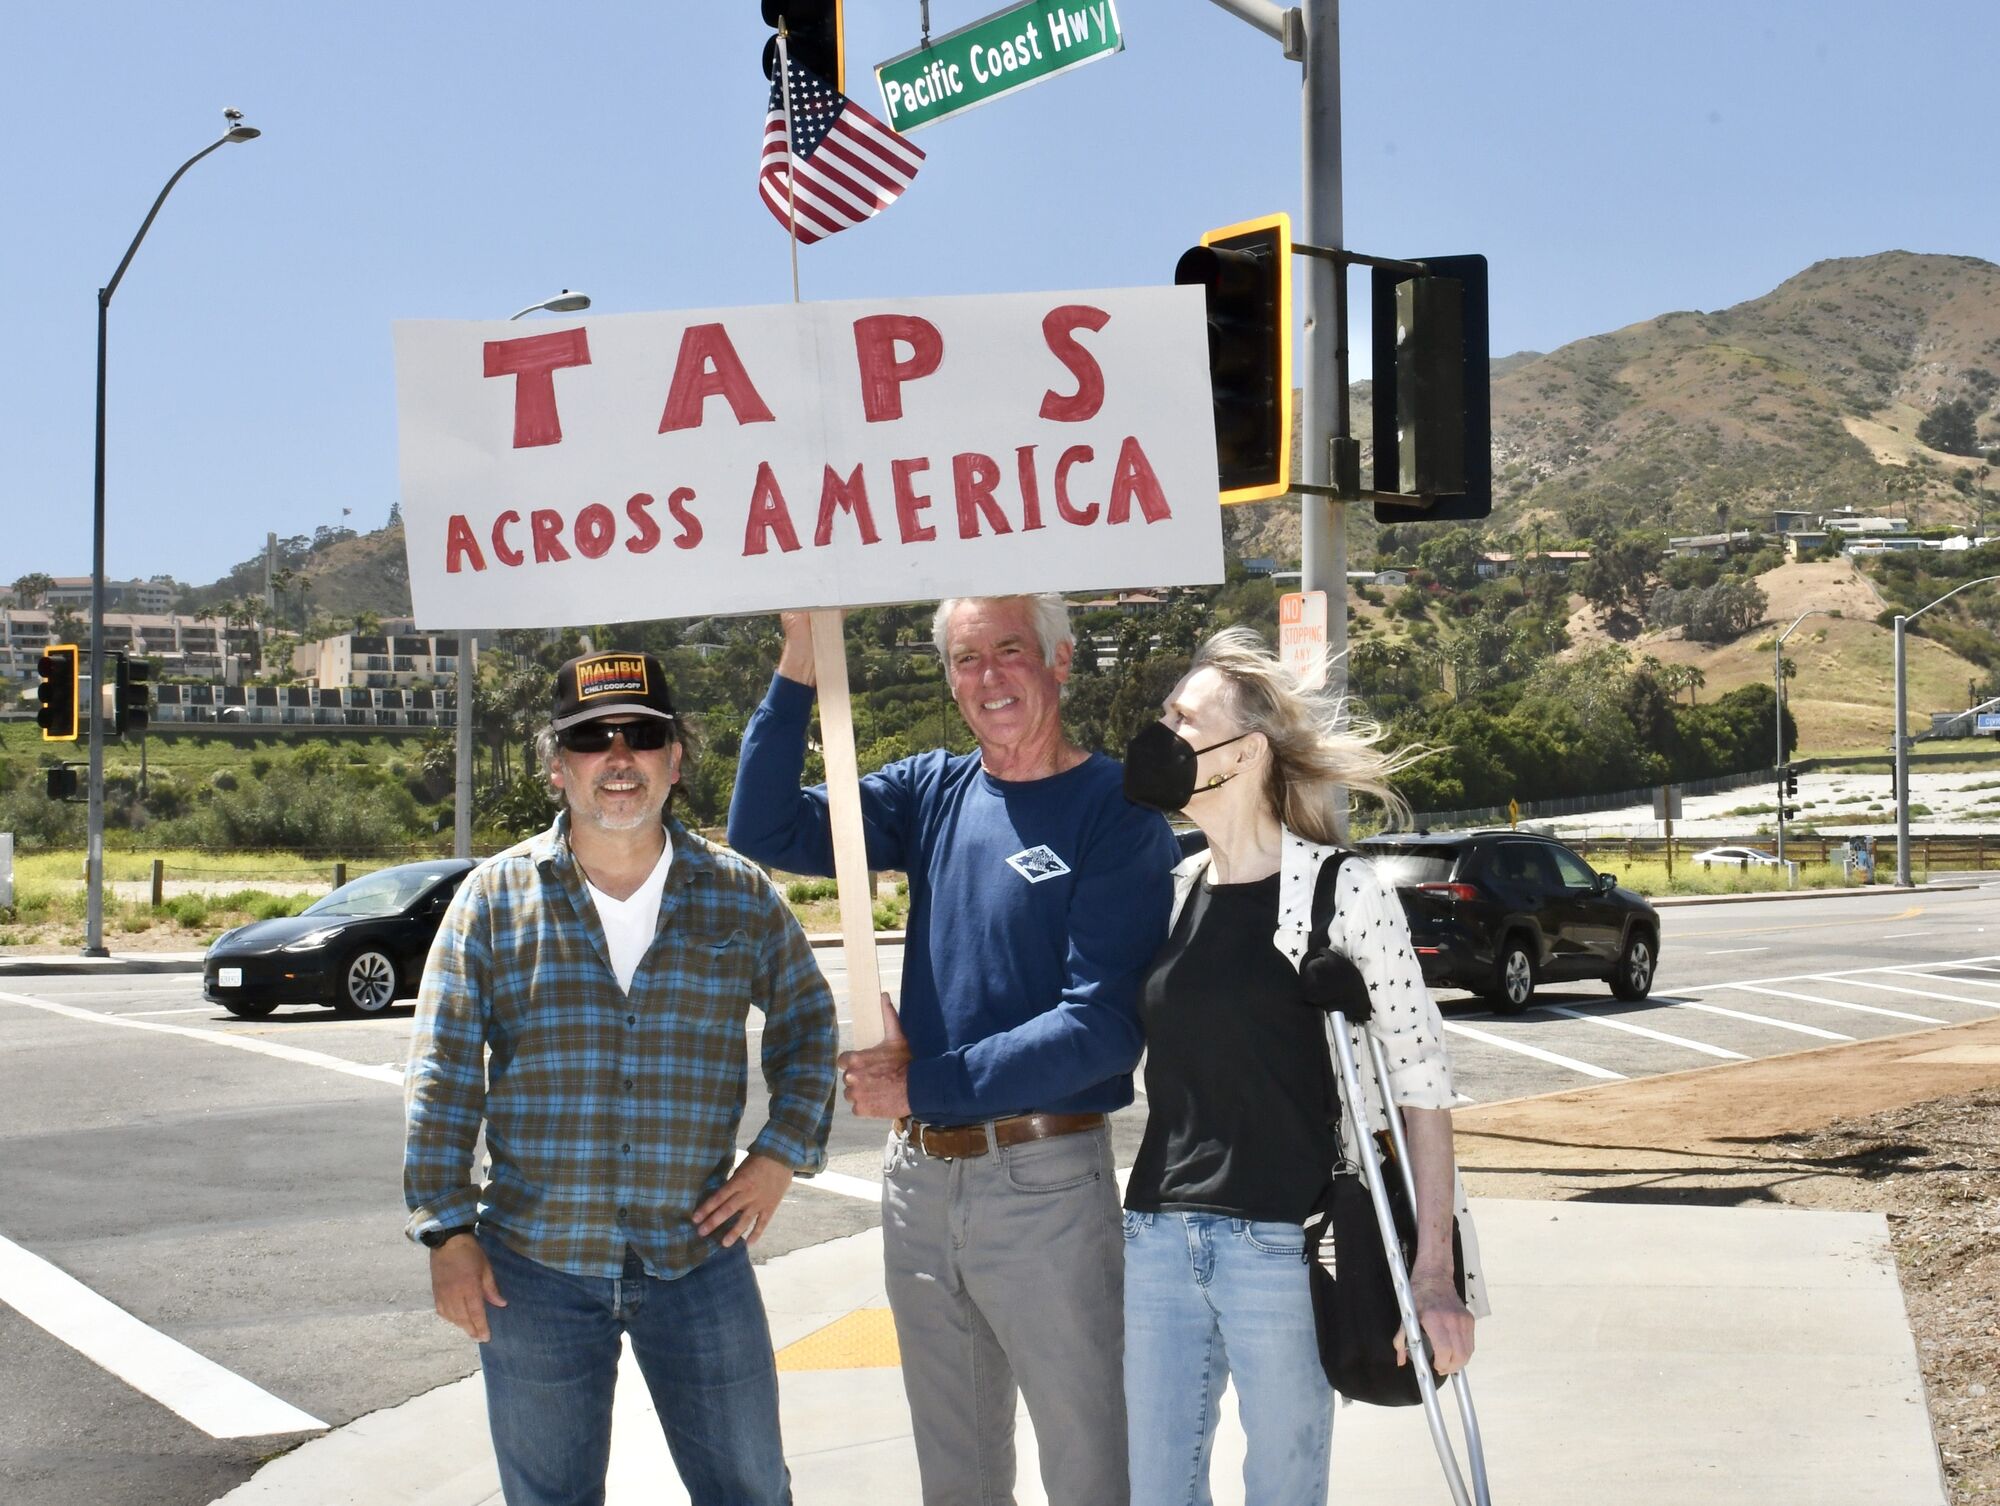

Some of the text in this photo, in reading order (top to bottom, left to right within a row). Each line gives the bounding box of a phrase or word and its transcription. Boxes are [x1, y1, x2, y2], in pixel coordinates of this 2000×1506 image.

[885, 2, 1107, 118] Pacific Coast Hwy
[483, 305, 1112, 448] TAPS
[446, 436, 1172, 573] ACROSS AMERICA
[1282, 598, 1299, 620] NO
[1284, 625, 1323, 645] STOPPING
[1294, 647, 1311, 661] ANY
[580, 661, 642, 682] MALIBU
[584, 682, 641, 695] CHILI COOK-OFF
